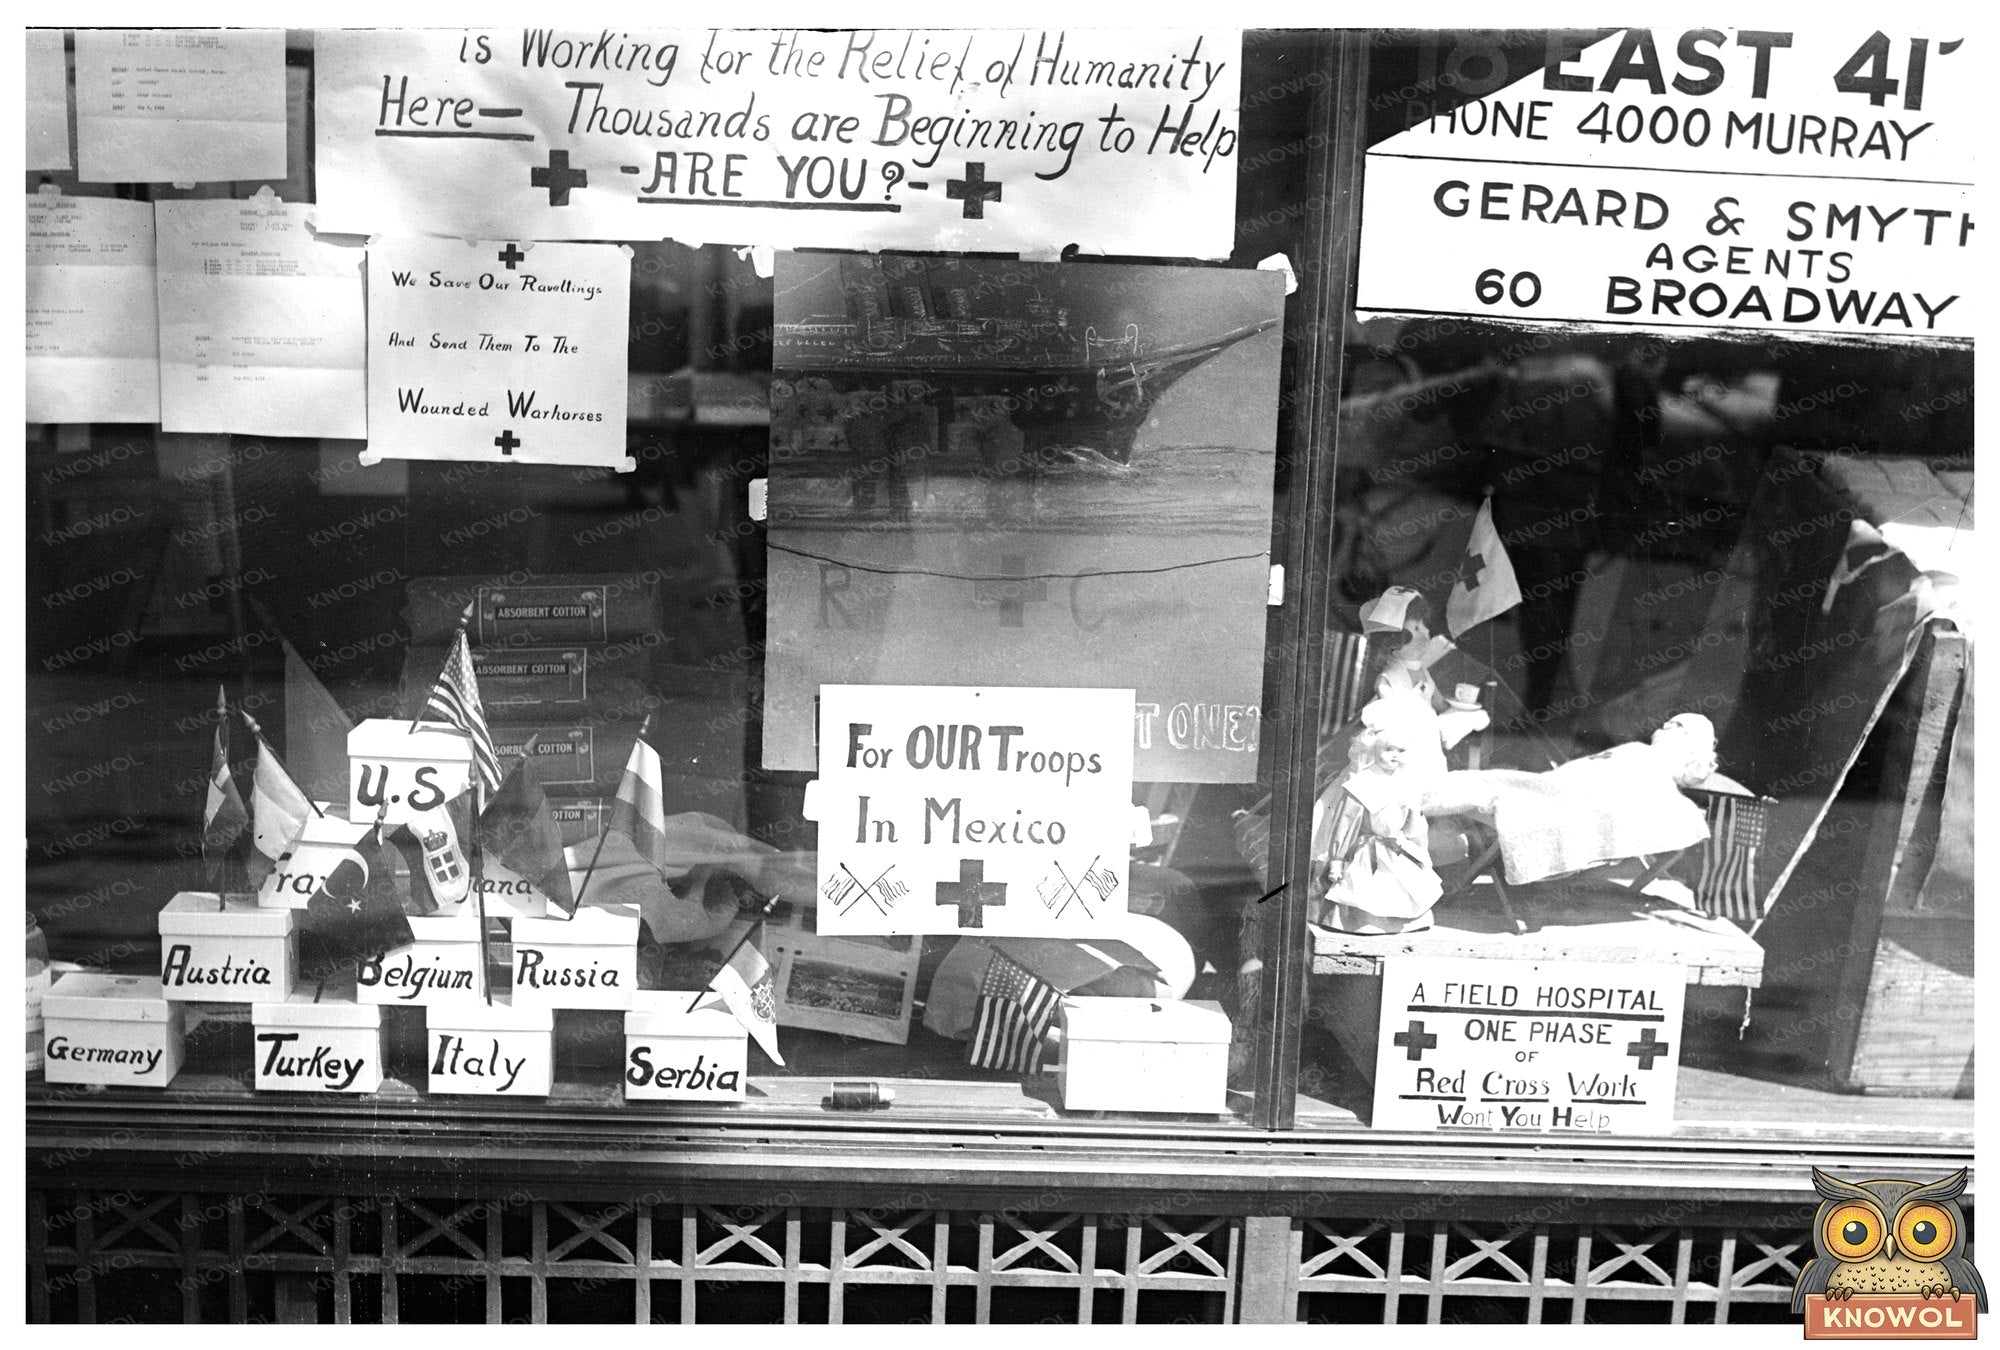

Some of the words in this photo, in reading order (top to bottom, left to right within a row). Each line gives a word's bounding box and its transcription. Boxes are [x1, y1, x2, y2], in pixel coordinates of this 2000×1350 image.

[460, 36, 492, 64] is
[700, 29, 752, 83] for
[769, 31, 825, 77] the
[838, 31, 973, 94] Relief
[986, 33, 1025, 99] of
[1031, 30, 1225, 103] Humanity
[1543, 28, 1793, 99] EAST
[565, 82, 770, 141] Thousands
[792, 112, 859, 143] are
[871, 93, 1085, 181] Beginning
[1098, 103, 1135, 153] to
[1147, 103, 1237, 174] Help
[1576, 102, 1710, 147] 4000
[1725, 111, 1935, 161] MURRAY
[1433, 180, 1669, 231] GERARD
[1706, 196, 1745, 236] &
[392, 271, 417, 288] We
[429, 271, 471, 289] Save
[478, 273, 510, 290] Our
[1645, 242, 1852, 283] AGENTS
[1475, 268, 1542, 308] 60
[1605, 275, 1960, 329] BROADWAY
[388, 332, 415, 347] And
[429, 333, 467, 350] Send
[478, 333, 512, 352] Them
[524, 334, 540, 353] To
[552, 336, 578, 354] The
[398, 387, 489, 417] Wounded
[507, 389, 603, 422] Warhorses
[498, 606, 549, 618] ABSORBENT
[552, 606, 586, 617] COTTON
[476, 663, 528, 675] ABSORBENT
[532, 663, 566, 674] COTTON
[538, 743, 573, 754] COTTON
[846, 723, 893, 769] For
[906, 724, 983, 771] OUR
[988, 725, 1101, 788] Troops
[552, 810, 581, 820] OTTON
[855, 795, 898, 844] In
[924, 796, 1066, 845] Mexico
[162, 944, 271, 986] Austria
[357, 952, 473, 1000] Belgium
[516, 949, 620, 989] Russia
[1411, 982, 1425, 1003] A
[1445, 983, 1518, 1007] FIELD
[1537, 986, 1664, 1011] HOSPITAL
[1464, 1018, 1517, 1042] ONE
[1530, 1021, 1613, 1045] PHASE
[46, 1036, 163, 1075] Germany
[431, 1034, 526, 1092] Italy
[626, 1046, 740, 1092] Serbia
[1515, 1051, 1540, 1063] OF
[1416, 1067, 1466, 1094] Red
[1481, 1070, 1550, 1096] Cross
[1567, 1072, 1637, 1097] Work
[1437, 1104, 1493, 1126] Wont
[1501, 1105, 1541, 1128] You
[1552, 1106, 1610, 1130] Help
